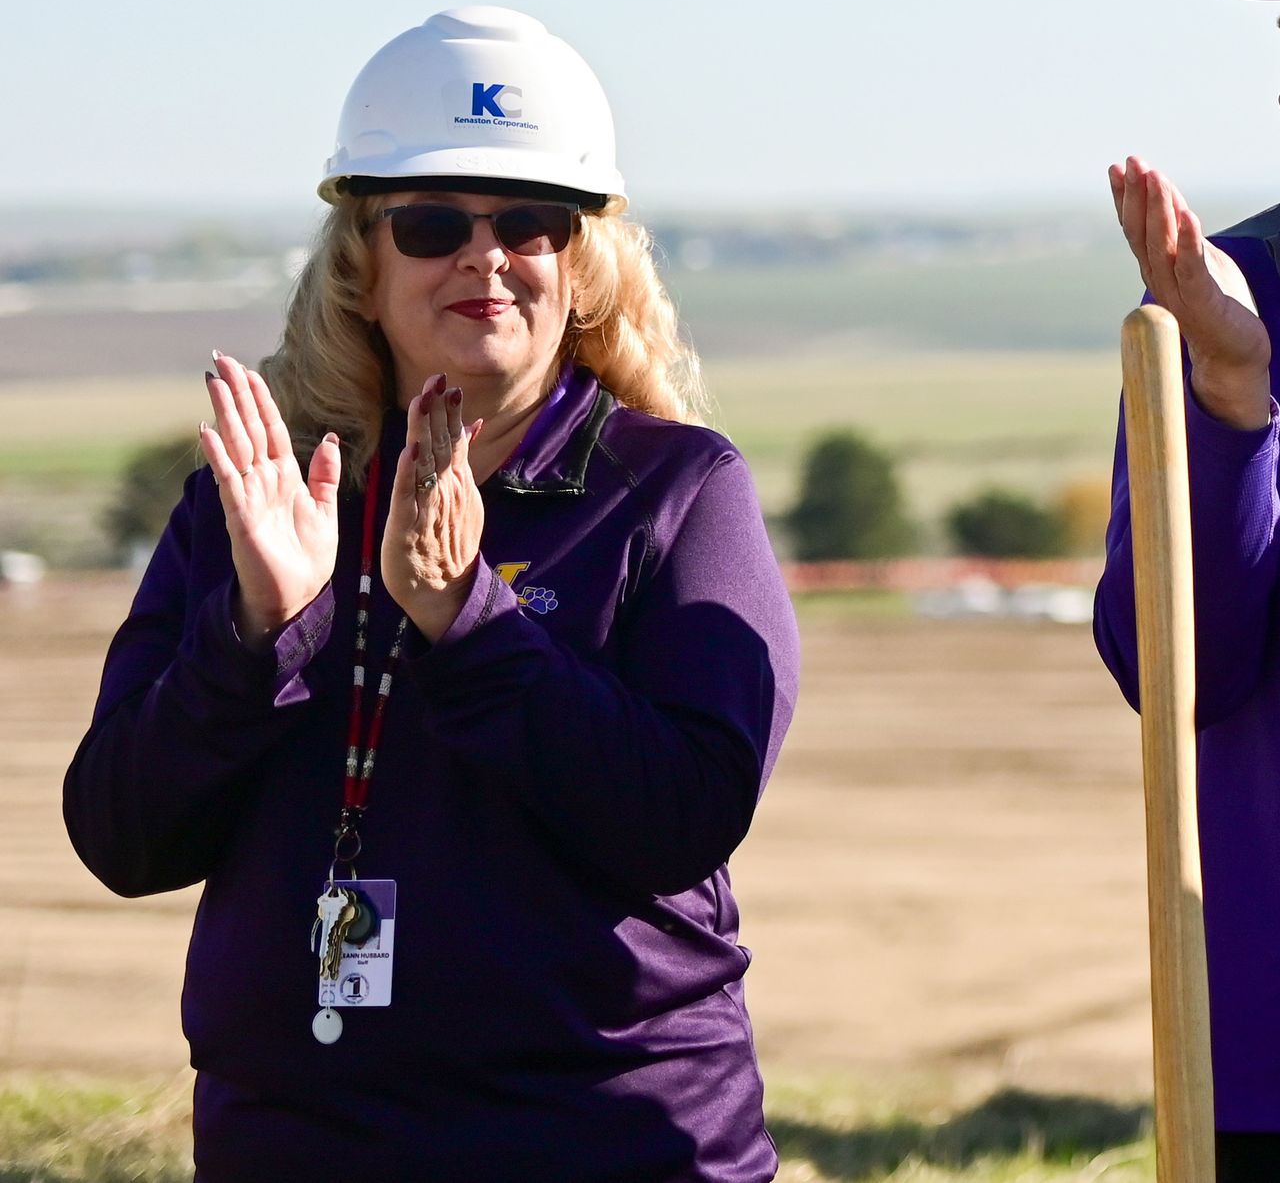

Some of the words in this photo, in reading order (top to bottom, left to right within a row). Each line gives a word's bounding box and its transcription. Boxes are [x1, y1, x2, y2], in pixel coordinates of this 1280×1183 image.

[471, 82, 523, 119] KC
[454, 116, 492, 125] Kenaston
[492, 118, 540, 131] Corporation
